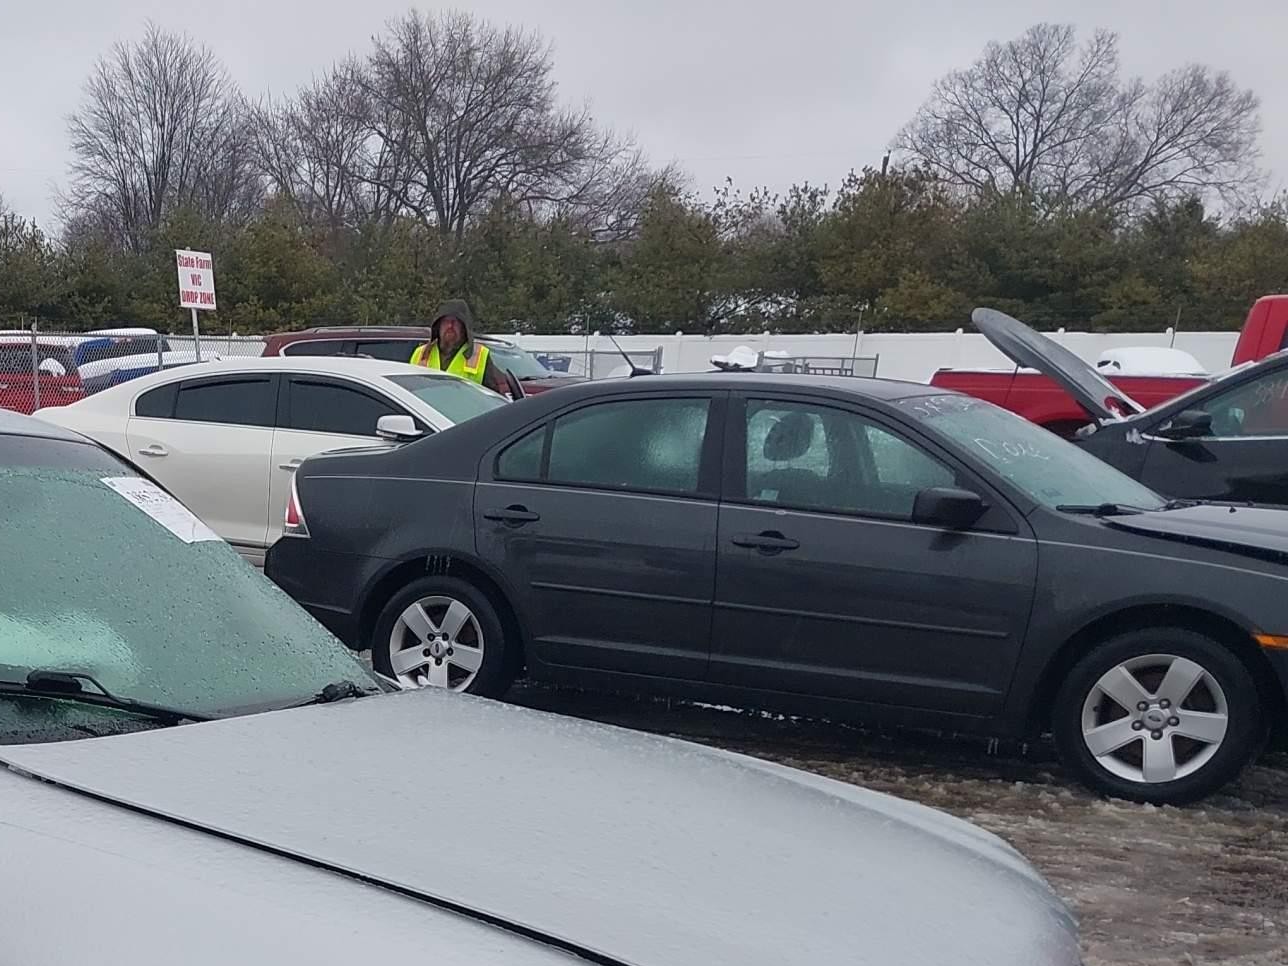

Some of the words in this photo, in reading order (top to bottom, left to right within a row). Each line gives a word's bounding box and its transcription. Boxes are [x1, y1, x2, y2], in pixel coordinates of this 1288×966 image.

[178, 254, 194, 268] State
[196, 256, 212, 270] Farm
[181, 290, 198, 304] DROP
[199, 292, 215, 305] ZONE
